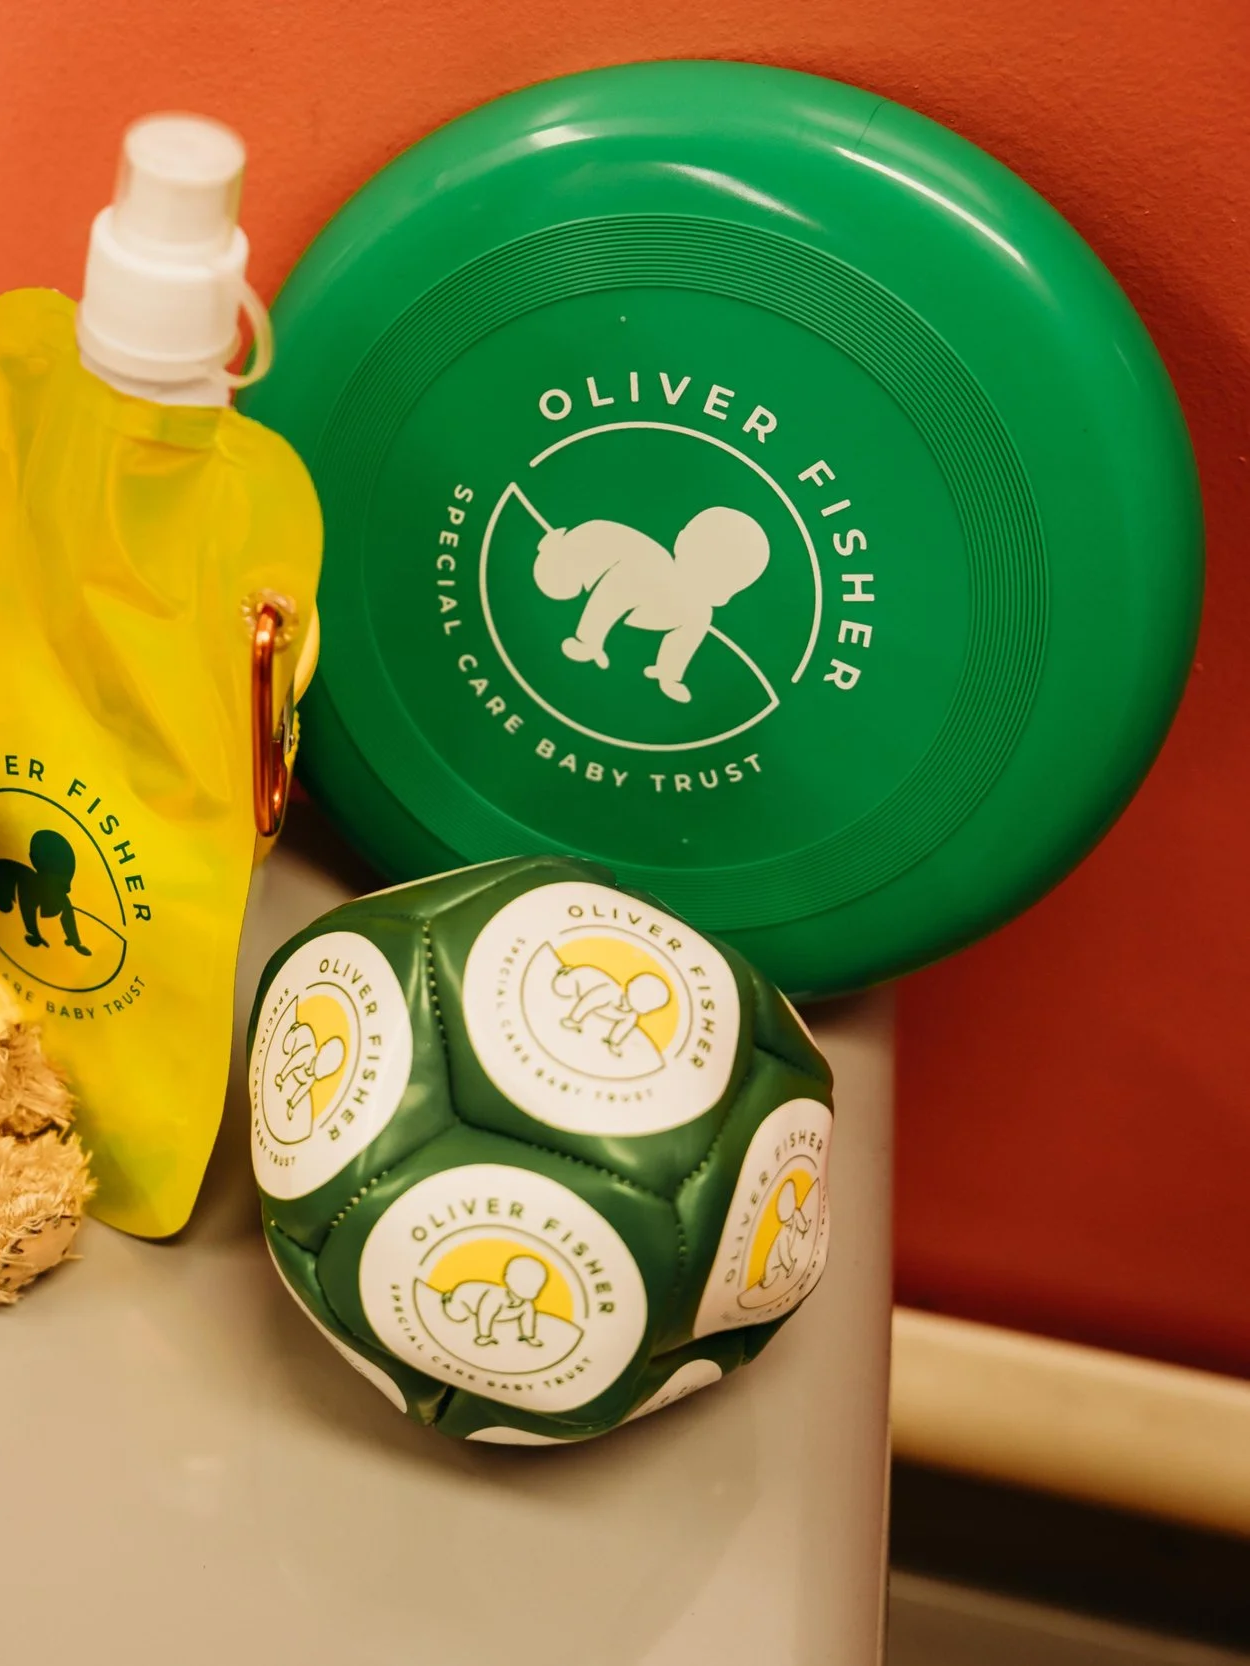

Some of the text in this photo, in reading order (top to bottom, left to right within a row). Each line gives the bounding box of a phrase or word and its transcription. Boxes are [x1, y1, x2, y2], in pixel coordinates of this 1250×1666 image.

[538, 371, 875, 691] OLIVER FISHER
[436, 484, 763, 793] SPECIAL CARE BABY TRUST
[67, 778, 152, 922] FISHER
[46, 1001, 96, 1020] BABY
[103, 975, 146, 1016] TRUST
[319, 958, 382, 1142] OLIVER FISHER
[567, 904, 717, 1069] OLIVER FISHER
[411, 1198, 616, 1314] OLIVER FISHER
[724, 1169, 769, 1284] OLIVER
[774, 1129, 824, 1162] FISHER
[390, 1283, 425, 1351] SPECIAL
[431, 1354, 476, 1382] CARE
[543, 1356, 593, 1389] TRUST
